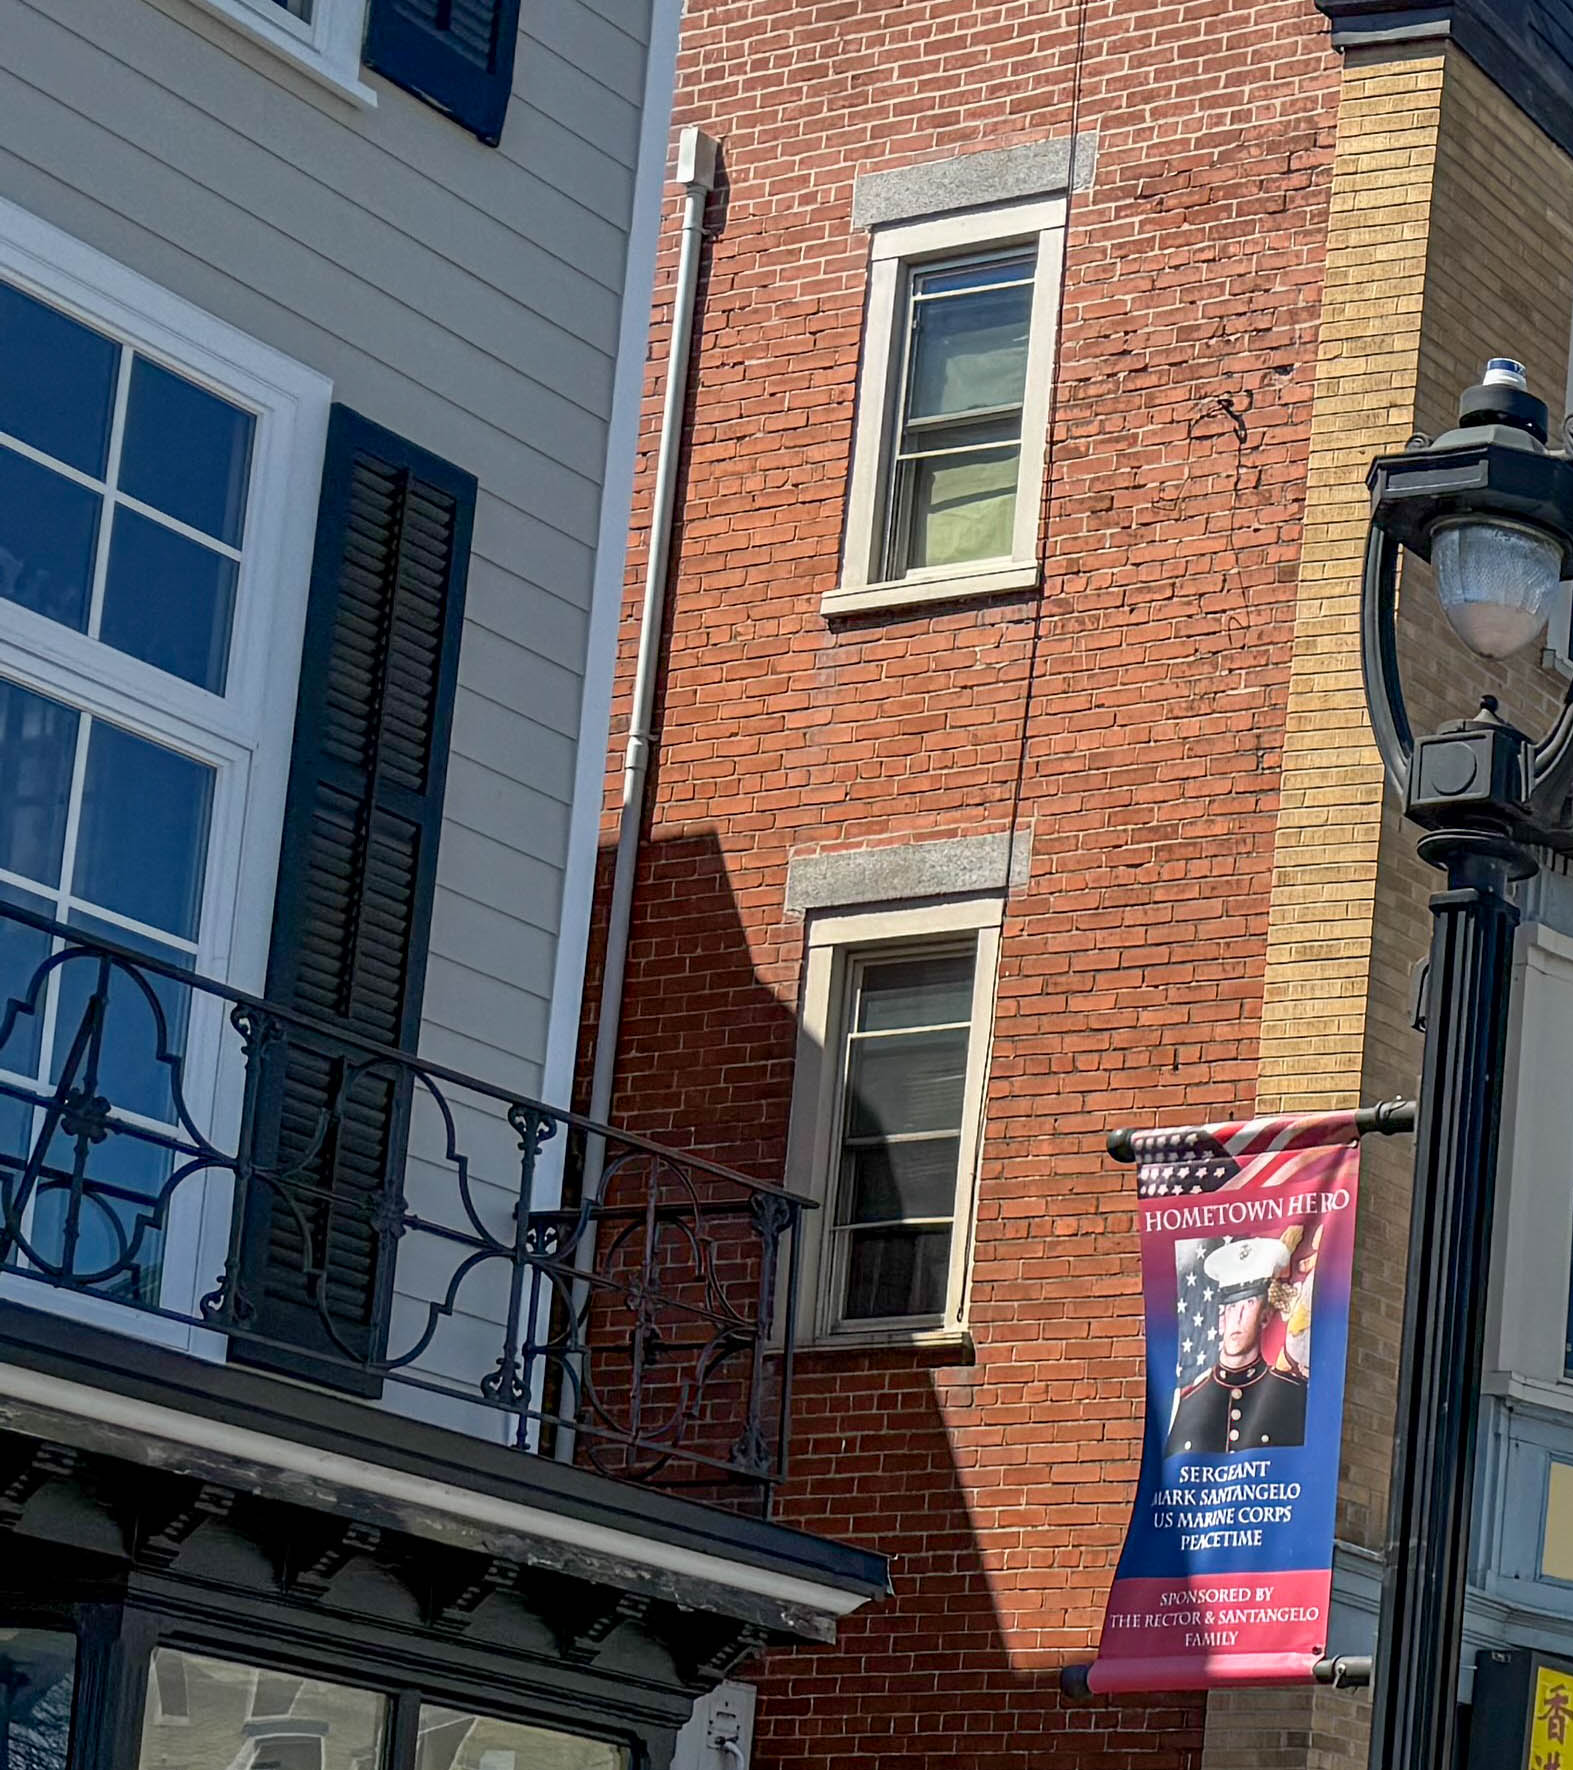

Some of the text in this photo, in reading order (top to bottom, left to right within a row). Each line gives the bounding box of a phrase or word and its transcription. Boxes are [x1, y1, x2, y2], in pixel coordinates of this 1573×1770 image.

[1145, 1190, 1350, 1232] HOMETOWN HERO
[1179, 1461, 1271, 1483] SERGEANT
[1199, 1482, 1301, 1506] SANTANGELO
[1153, 1505, 1292, 1528] US MARINE CORPS
[1181, 1530, 1262, 1551] PEACETIME
[1159, 1587, 1275, 1607] SPONSORED BY
[1110, 1607, 1319, 1629] THE RECTOR & SANTANGELO
[1184, 1631, 1239, 1647] FAMILY
